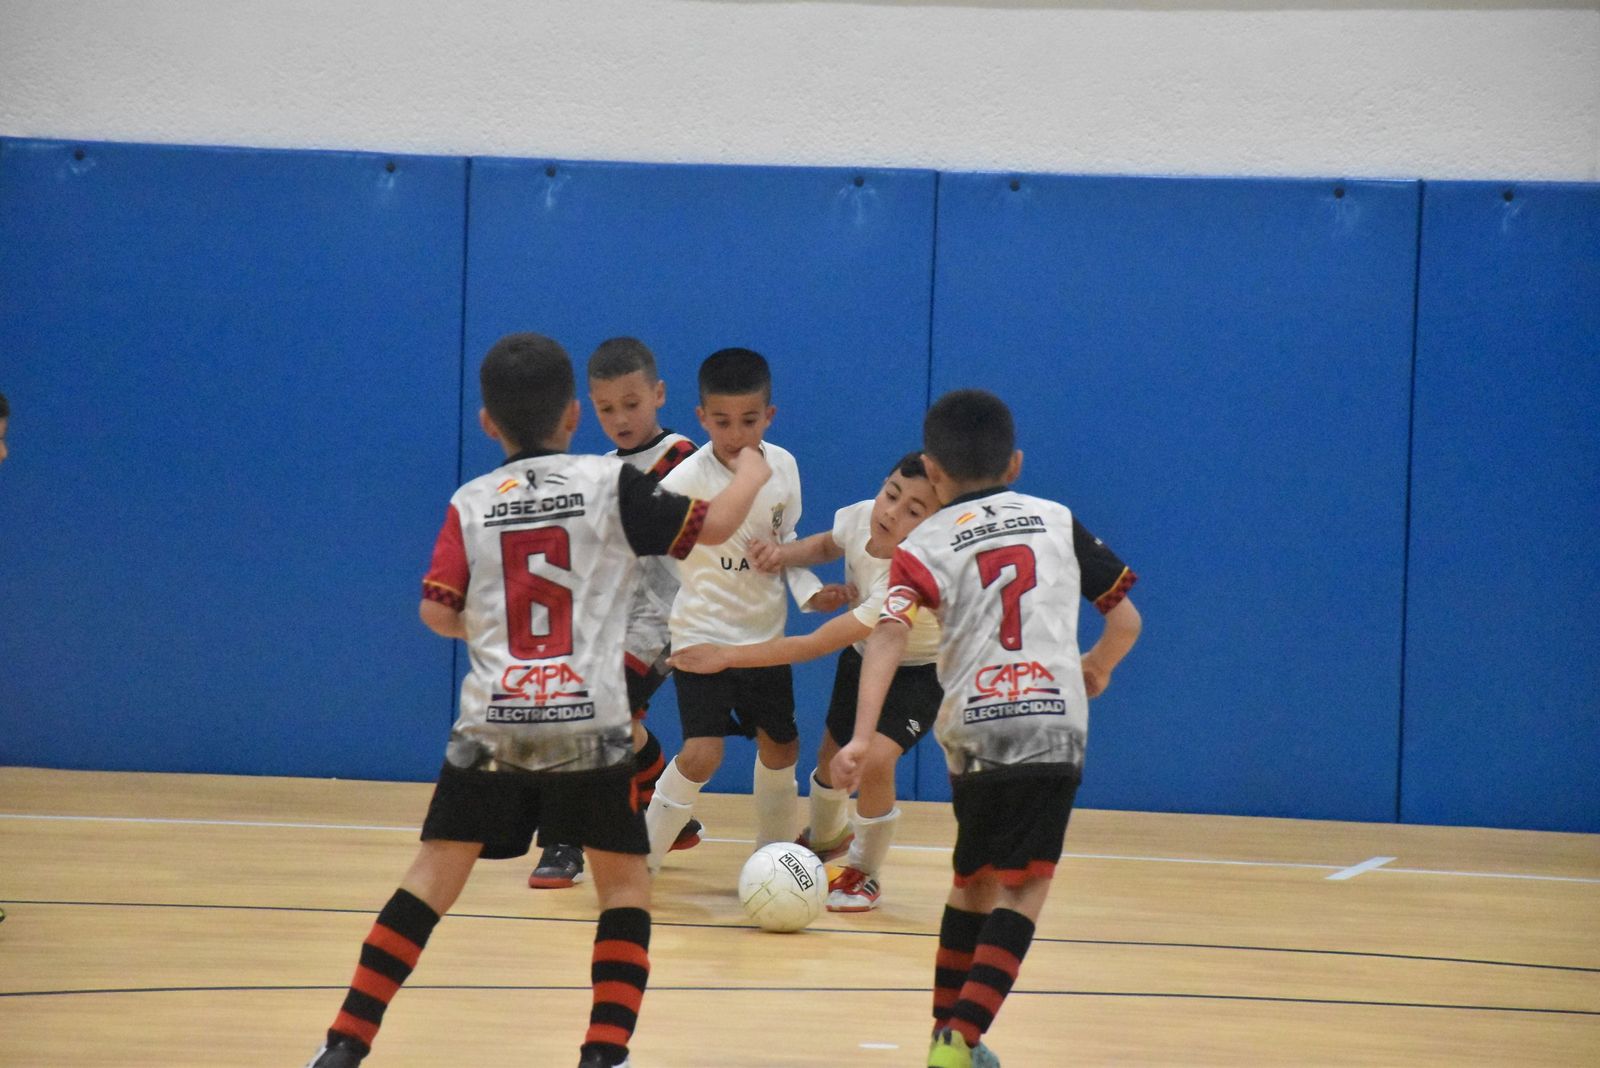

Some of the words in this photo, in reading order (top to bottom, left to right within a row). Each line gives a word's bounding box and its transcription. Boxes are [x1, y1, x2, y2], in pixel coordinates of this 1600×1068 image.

[484, 493, 584, 518] JOSE.COM
[950, 515, 1045, 546] JOSE.COM
[501, 525, 573, 660] 6
[975, 543, 1037, 651] 7
[502, 663, 584, 692] CAPA
[975, 661, 1055, 693] CAPA
[488, 703, 593, 720] ELECTRICIDAD
[965, 701, 1064, 722] ELECTRICIDAD
[784, 853, 812, 890] MUNICH
